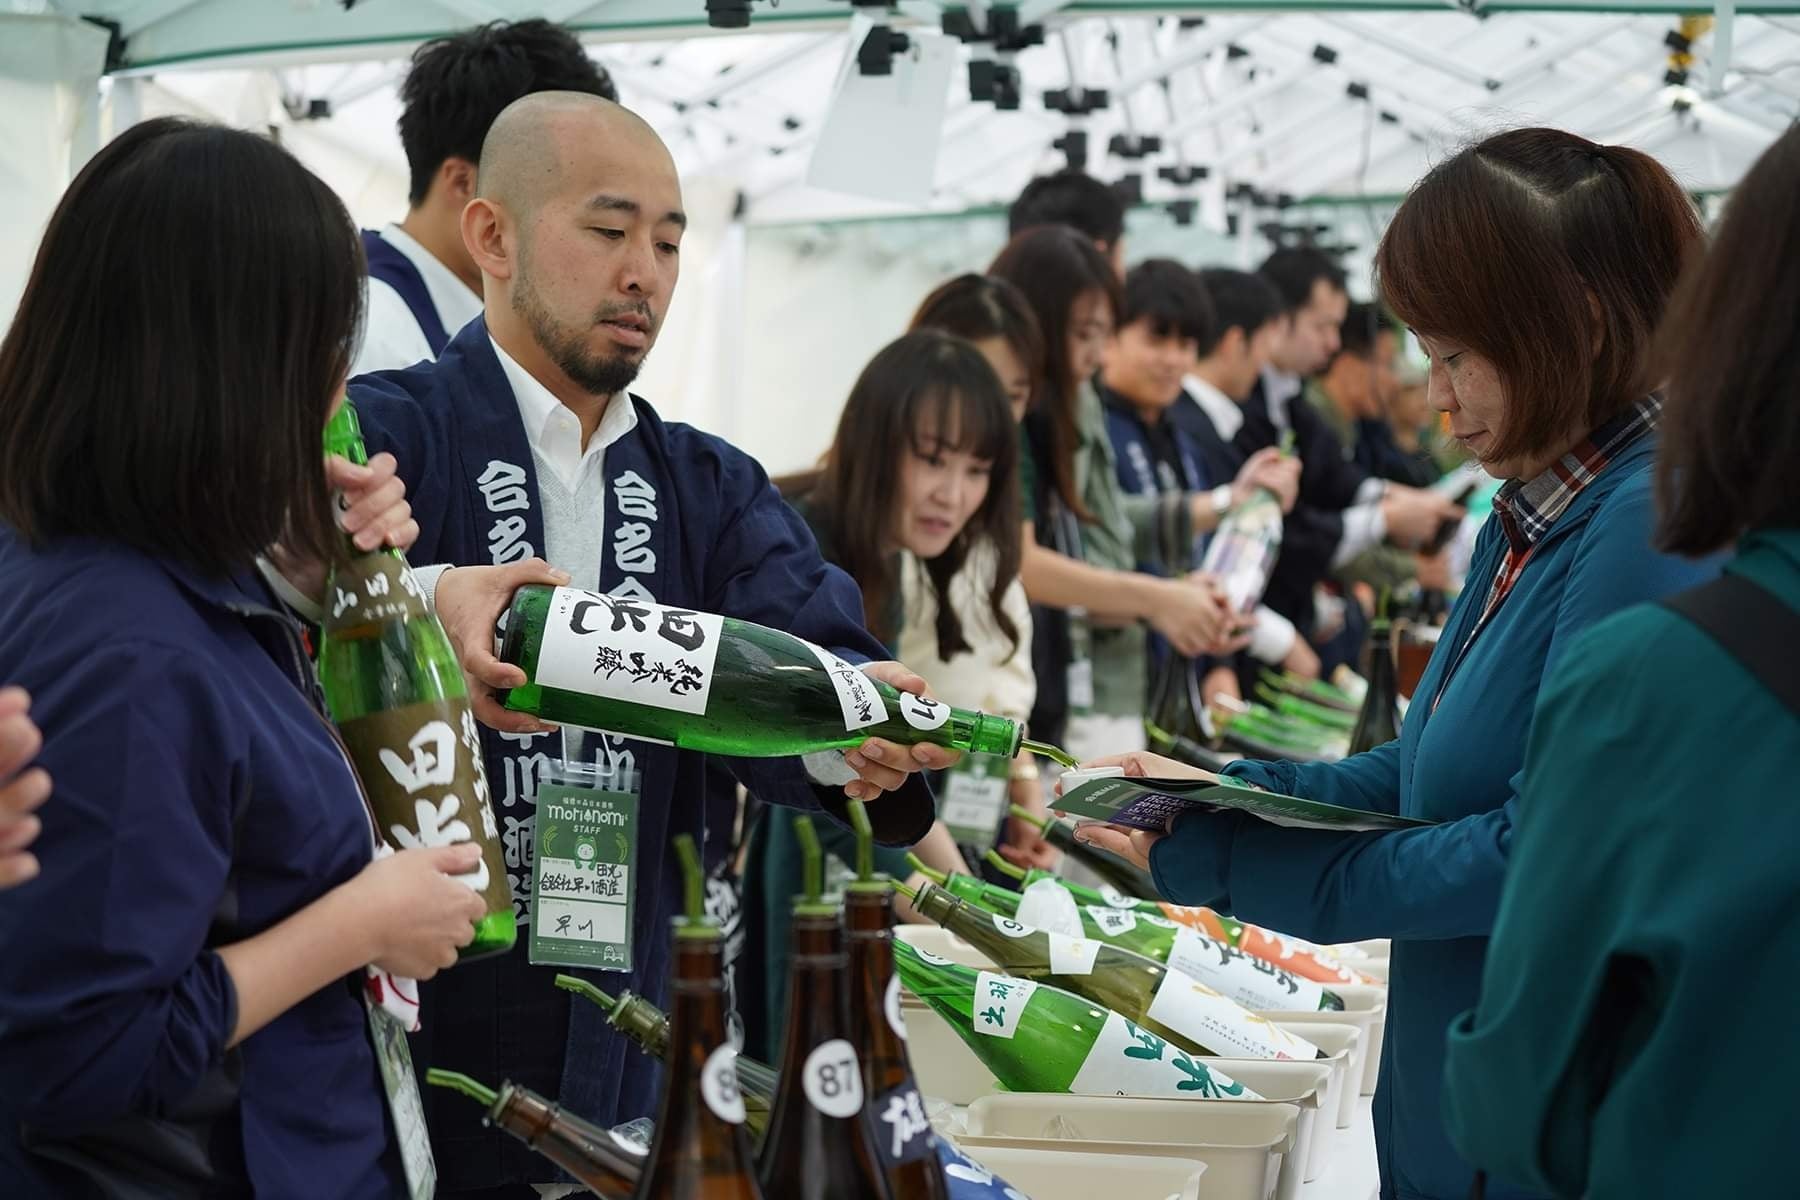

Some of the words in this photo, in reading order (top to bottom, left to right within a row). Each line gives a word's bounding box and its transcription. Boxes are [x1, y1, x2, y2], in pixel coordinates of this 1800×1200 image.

[573, 824, 601, 835] STAFF
[717, 1068, 740, 1103] 8
[817, 1060, 856, 1099] 87
